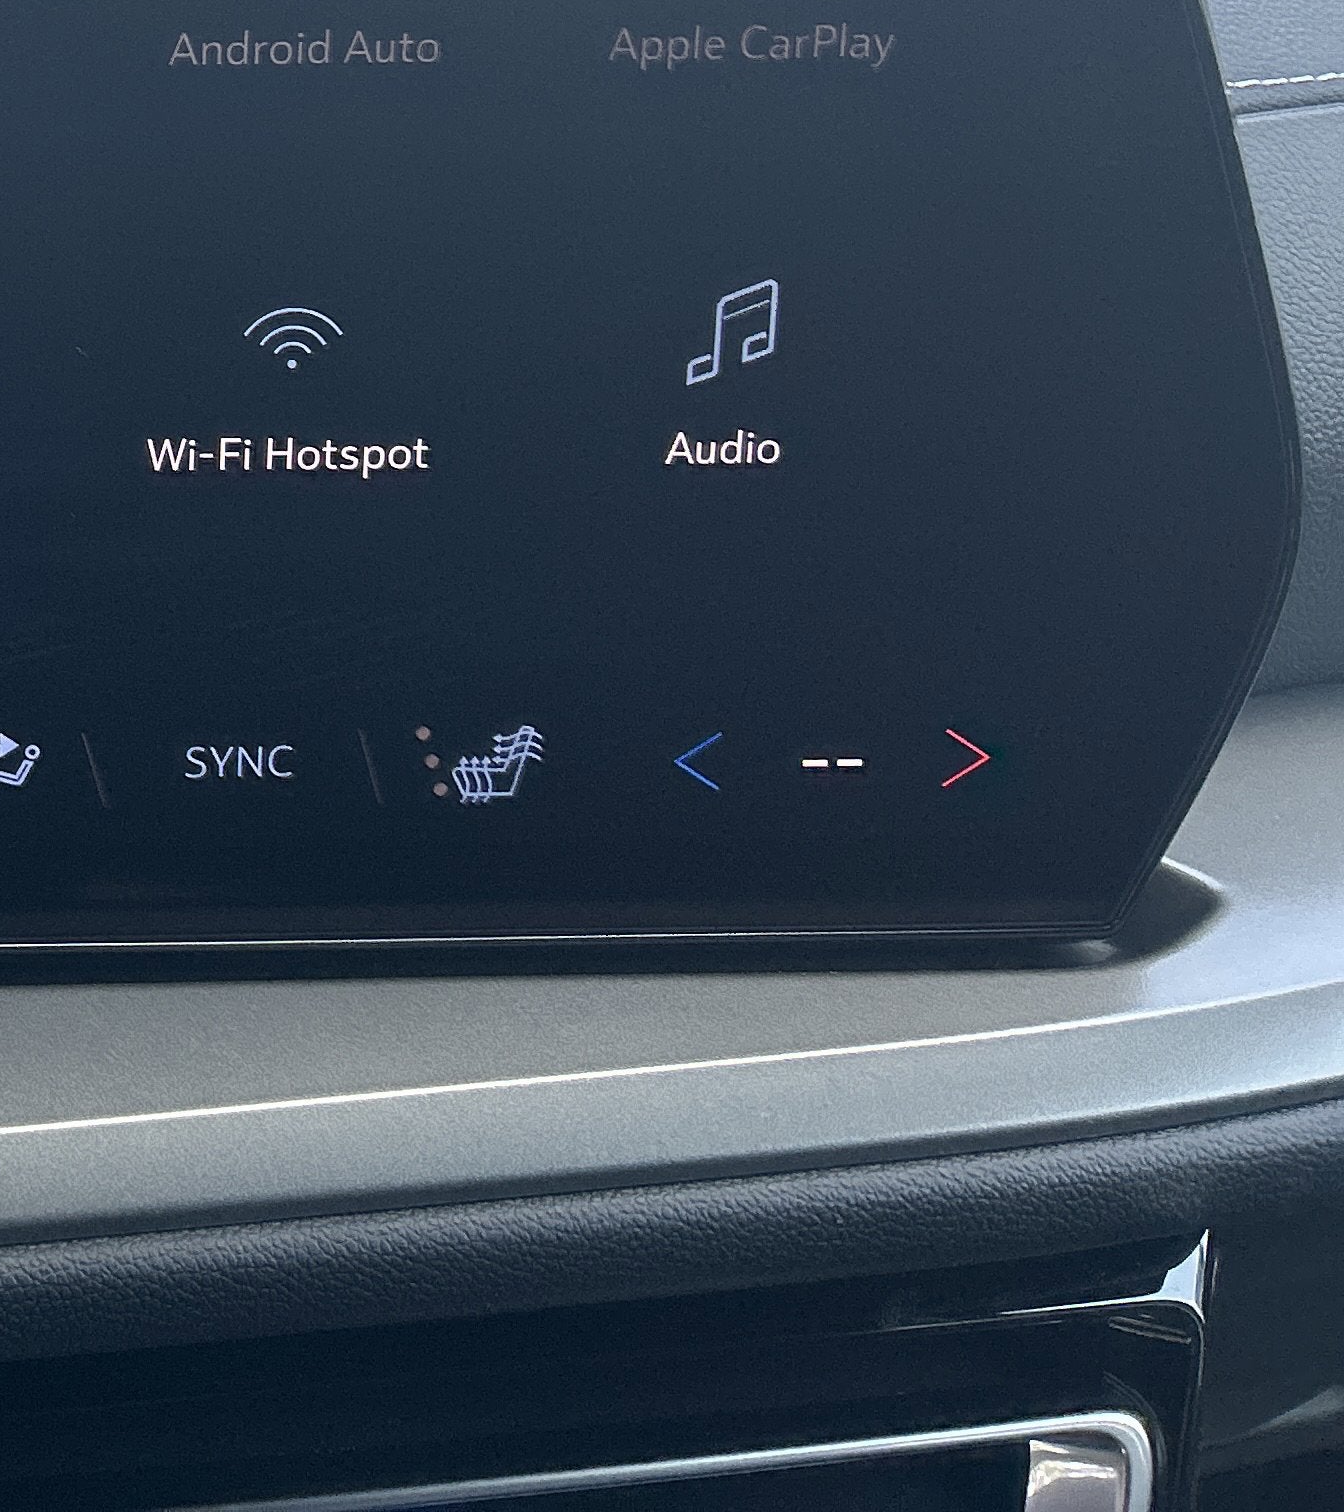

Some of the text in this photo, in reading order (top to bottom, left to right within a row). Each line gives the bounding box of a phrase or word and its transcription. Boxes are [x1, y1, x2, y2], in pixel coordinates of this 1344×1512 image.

[168, 28, 439, 66] Android Auto
[609, 22, 895, 71] Apple CarPlay
[147, 437, 429, 479] Wi-Fi Hotspot
[664, 429, 781, 465] Audio
[184, 744, 293, 779] SYNC
